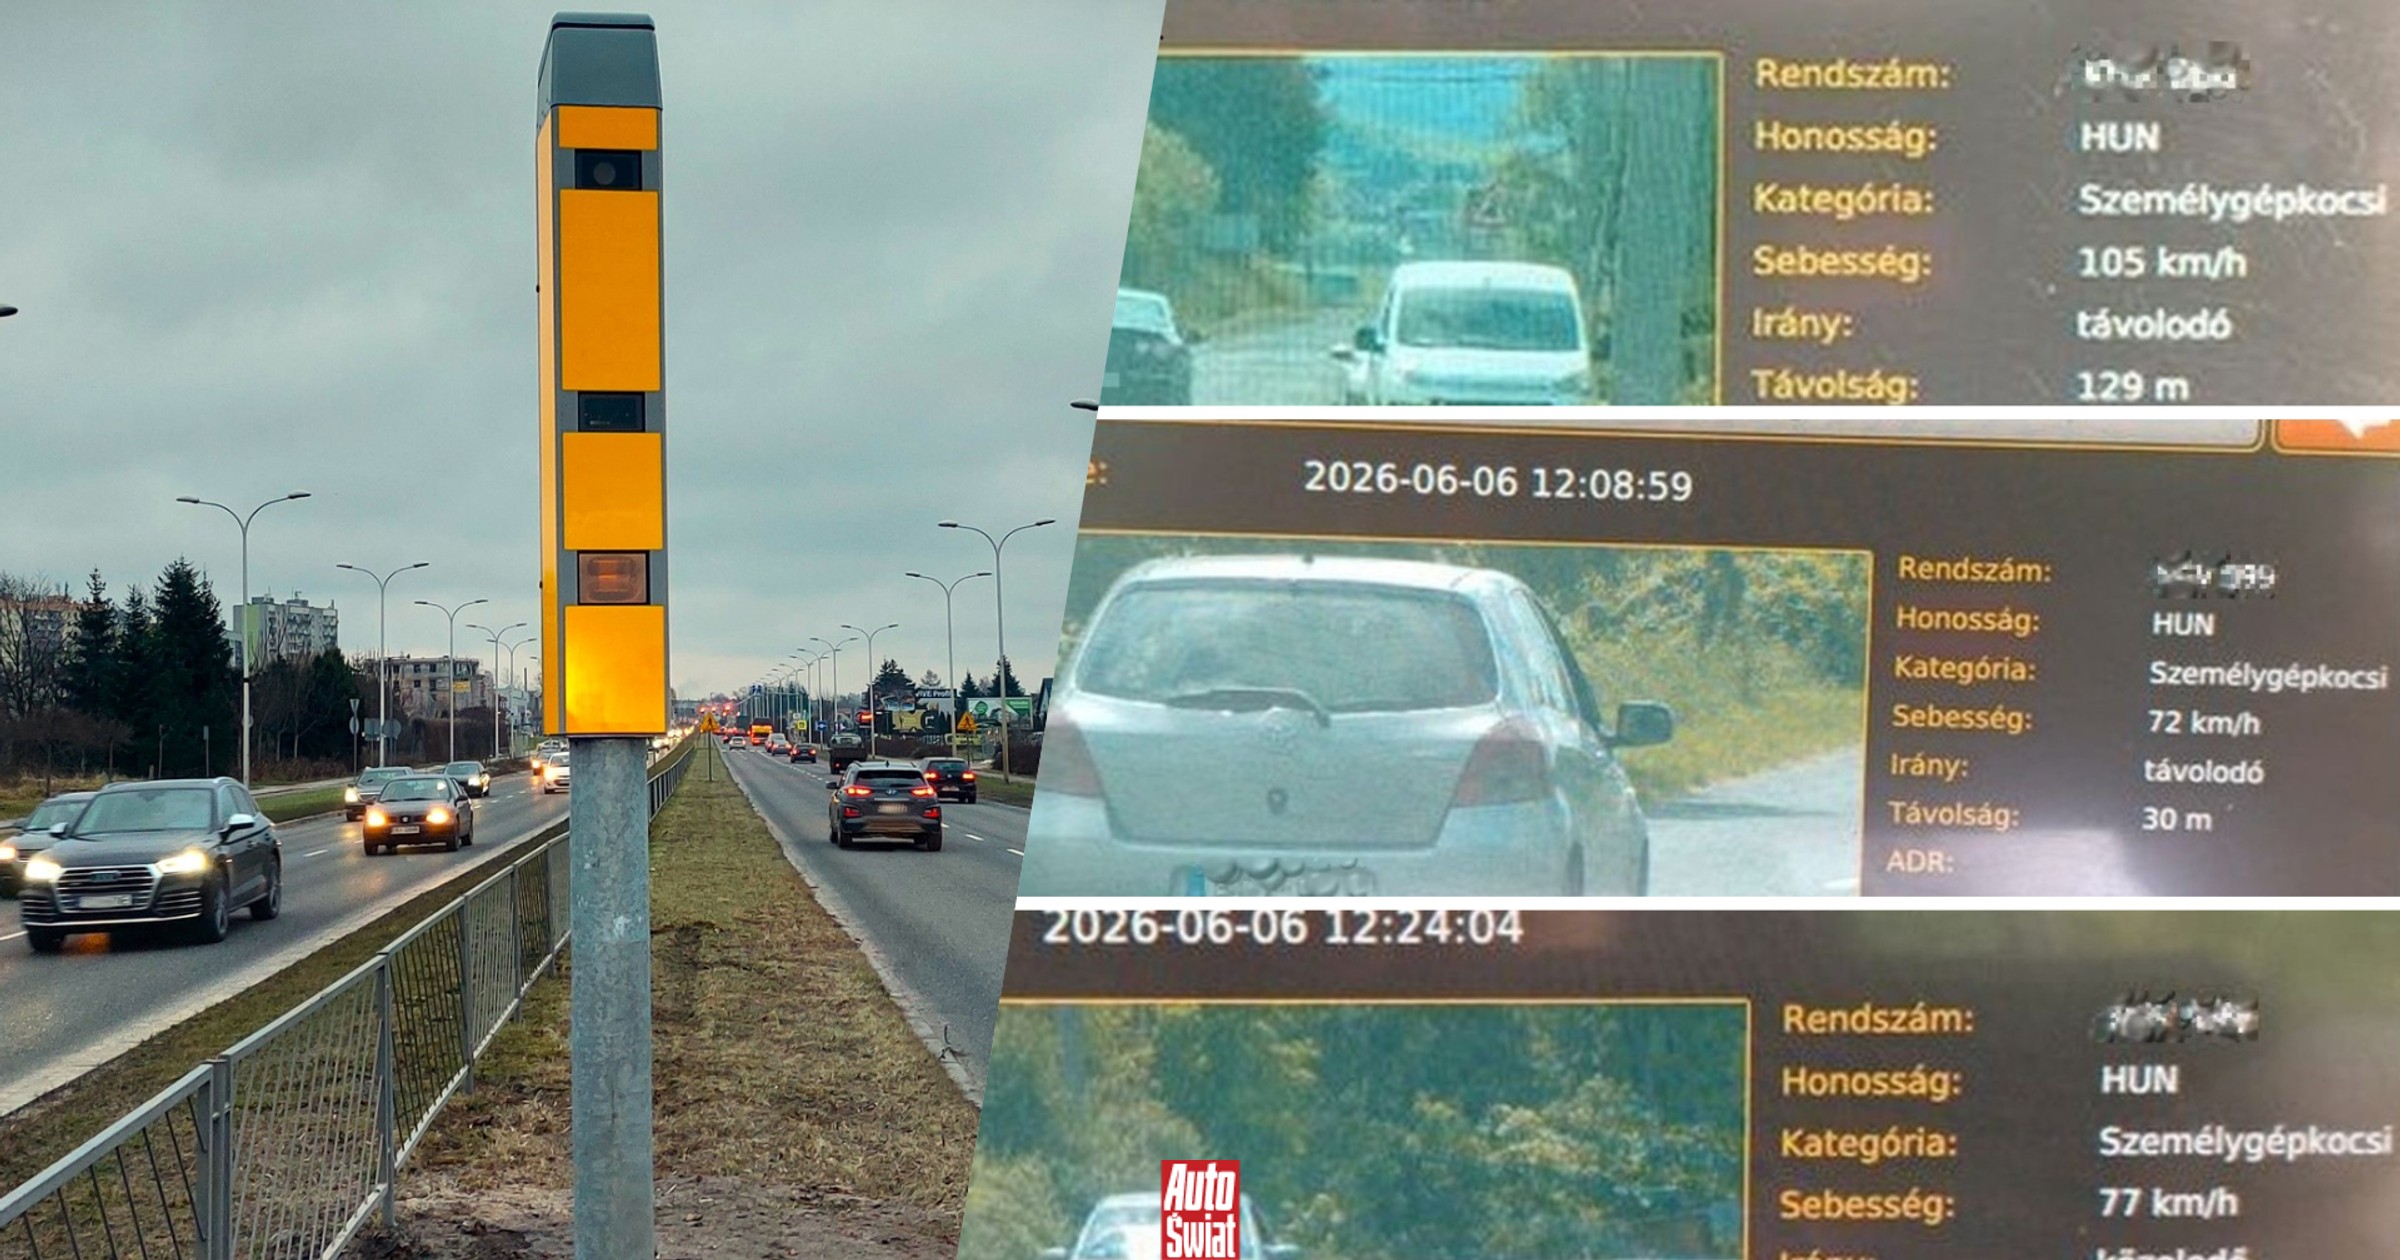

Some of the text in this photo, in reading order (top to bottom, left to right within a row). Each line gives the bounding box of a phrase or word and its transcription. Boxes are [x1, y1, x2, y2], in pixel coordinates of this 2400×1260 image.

[1757, 57, 1949, 89] Rendszám:
[1756, 120, 1936, 158] Honosság:
[2081, 122, 2160, 152] HUN
[1753, 183, 1934, 221] Kategória:
[2079, 182, 2386, 222] Személygépkocsi
[1753, 244, 1931, 282] Sebesség:
[2080, 246, 2247, 279] 105 km/h
[1753, 307, 1852, 344] Irány:
[2077, 307, 2232, 340] távolodó
[1752, 369, 1918, 405] Távolság:
[2078, 370, 2189, 401] 129 m
[1305, 460, 1692, 502] 2026-06-06 12:08:59
[1898, 555, 2052, 583] Rendszám:
[1896, 605, 2039, 637] Honosság:
[2153, 612, 2214, 636] HUN
[1894, 656, 2036, 686] Kategória:
[2150, 660, 2387, 693] Személygépkocsi
[1892, 704, 2032, 736] Sebesség:
[2149, 709, 2261, 737] 72 km/h
[1891, 752, 1968, 783] Irány:
[2144, 758, 2264, 784] távolodó
[1889, 801, 2019, 834] Távolság:
[2142, 806, 2212, 830] 30 m
[1886, 849, 1953, 873] ADR:
[1044, 909, 1524, 944] 2026-06-06 12:24:04
[1783, 1003, 1974, 1033] Rendszám:
[1782, 1066, 1962, 1102] Honosság:
[2102, 1065, 2178, 1094] HUN
[1781, 1127, 1957, 1163] Kategória:
[2099, 1125, 2391, 1162] Személygépkocsi
[1780, 1189, 1955, 1226] Sebesség:
[2099, 1187, 2238, 1219] 77 km/h
